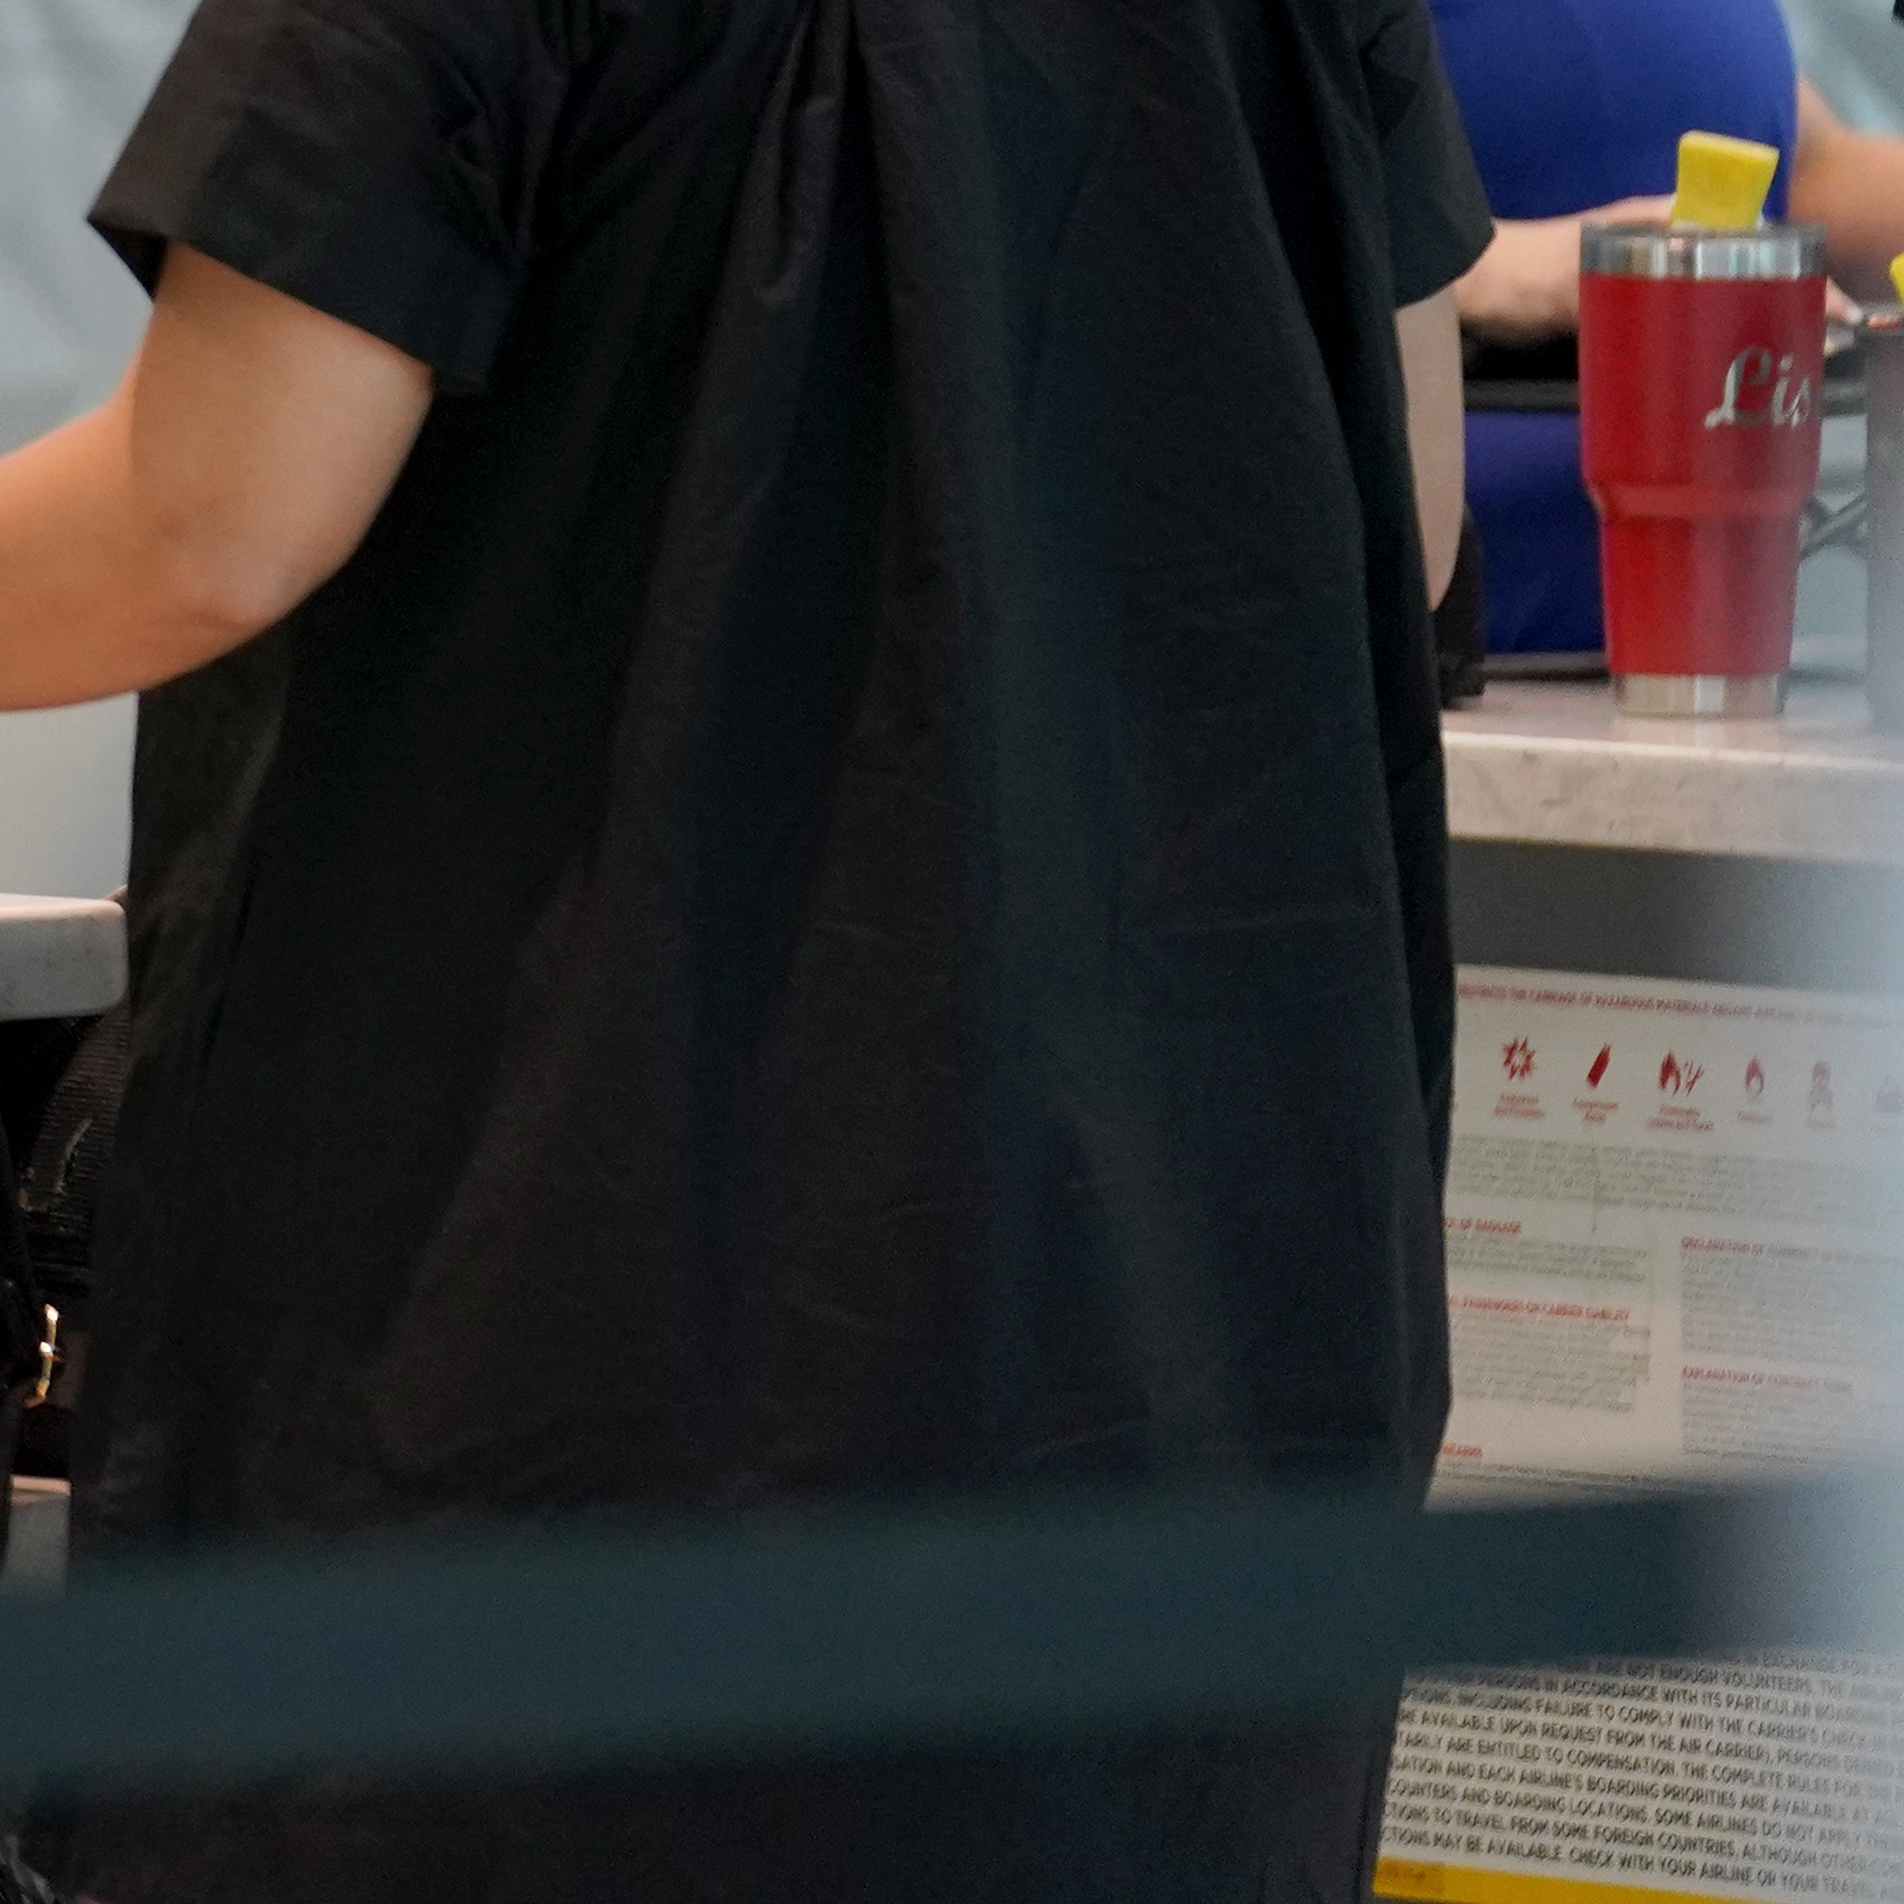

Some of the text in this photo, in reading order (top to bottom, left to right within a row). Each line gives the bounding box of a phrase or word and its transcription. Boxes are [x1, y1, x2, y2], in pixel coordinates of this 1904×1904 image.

[1662, 1686, 1699, 1705] WITH
[1597, 1704, 1615, 1721] TO
[1679, 1712, 1714, 1731] WITH
[1718, 1716, 1742, 1733] THE
[1542, 1721, 1602, 1742] REQUEST
[1607, 1728, 1644, 1747] FROM
[1650, 1732, 1674, 1750] THE
[1478, 1738, 1542, 1760] ENTITLED
[1683, 1761, 1708, 1779] THE
[1479, 1764, 1516, 1783] EACH
[1586, 1776, 1660, 1799] BOARDING
[1494, 1788, 1566, 1811] BOARDING
[1655, 1805, 1694, 1825] SOME
[1509, 1816, 1550, 1835] FROM
[1553, 1821, 1590, 1840] SOME
[1593, 1825, 1655, 1847] FOREIGN
[1432, 1832, 1463, 1850] MAY
[1568, 1847, 1615, 1868] CHECK
[1619, 1853, 1655, 1872] WITH
[1659, 1858, 1697, 1877] YOUR
[1699, 1862, 1755, 1884] AIRLINE
